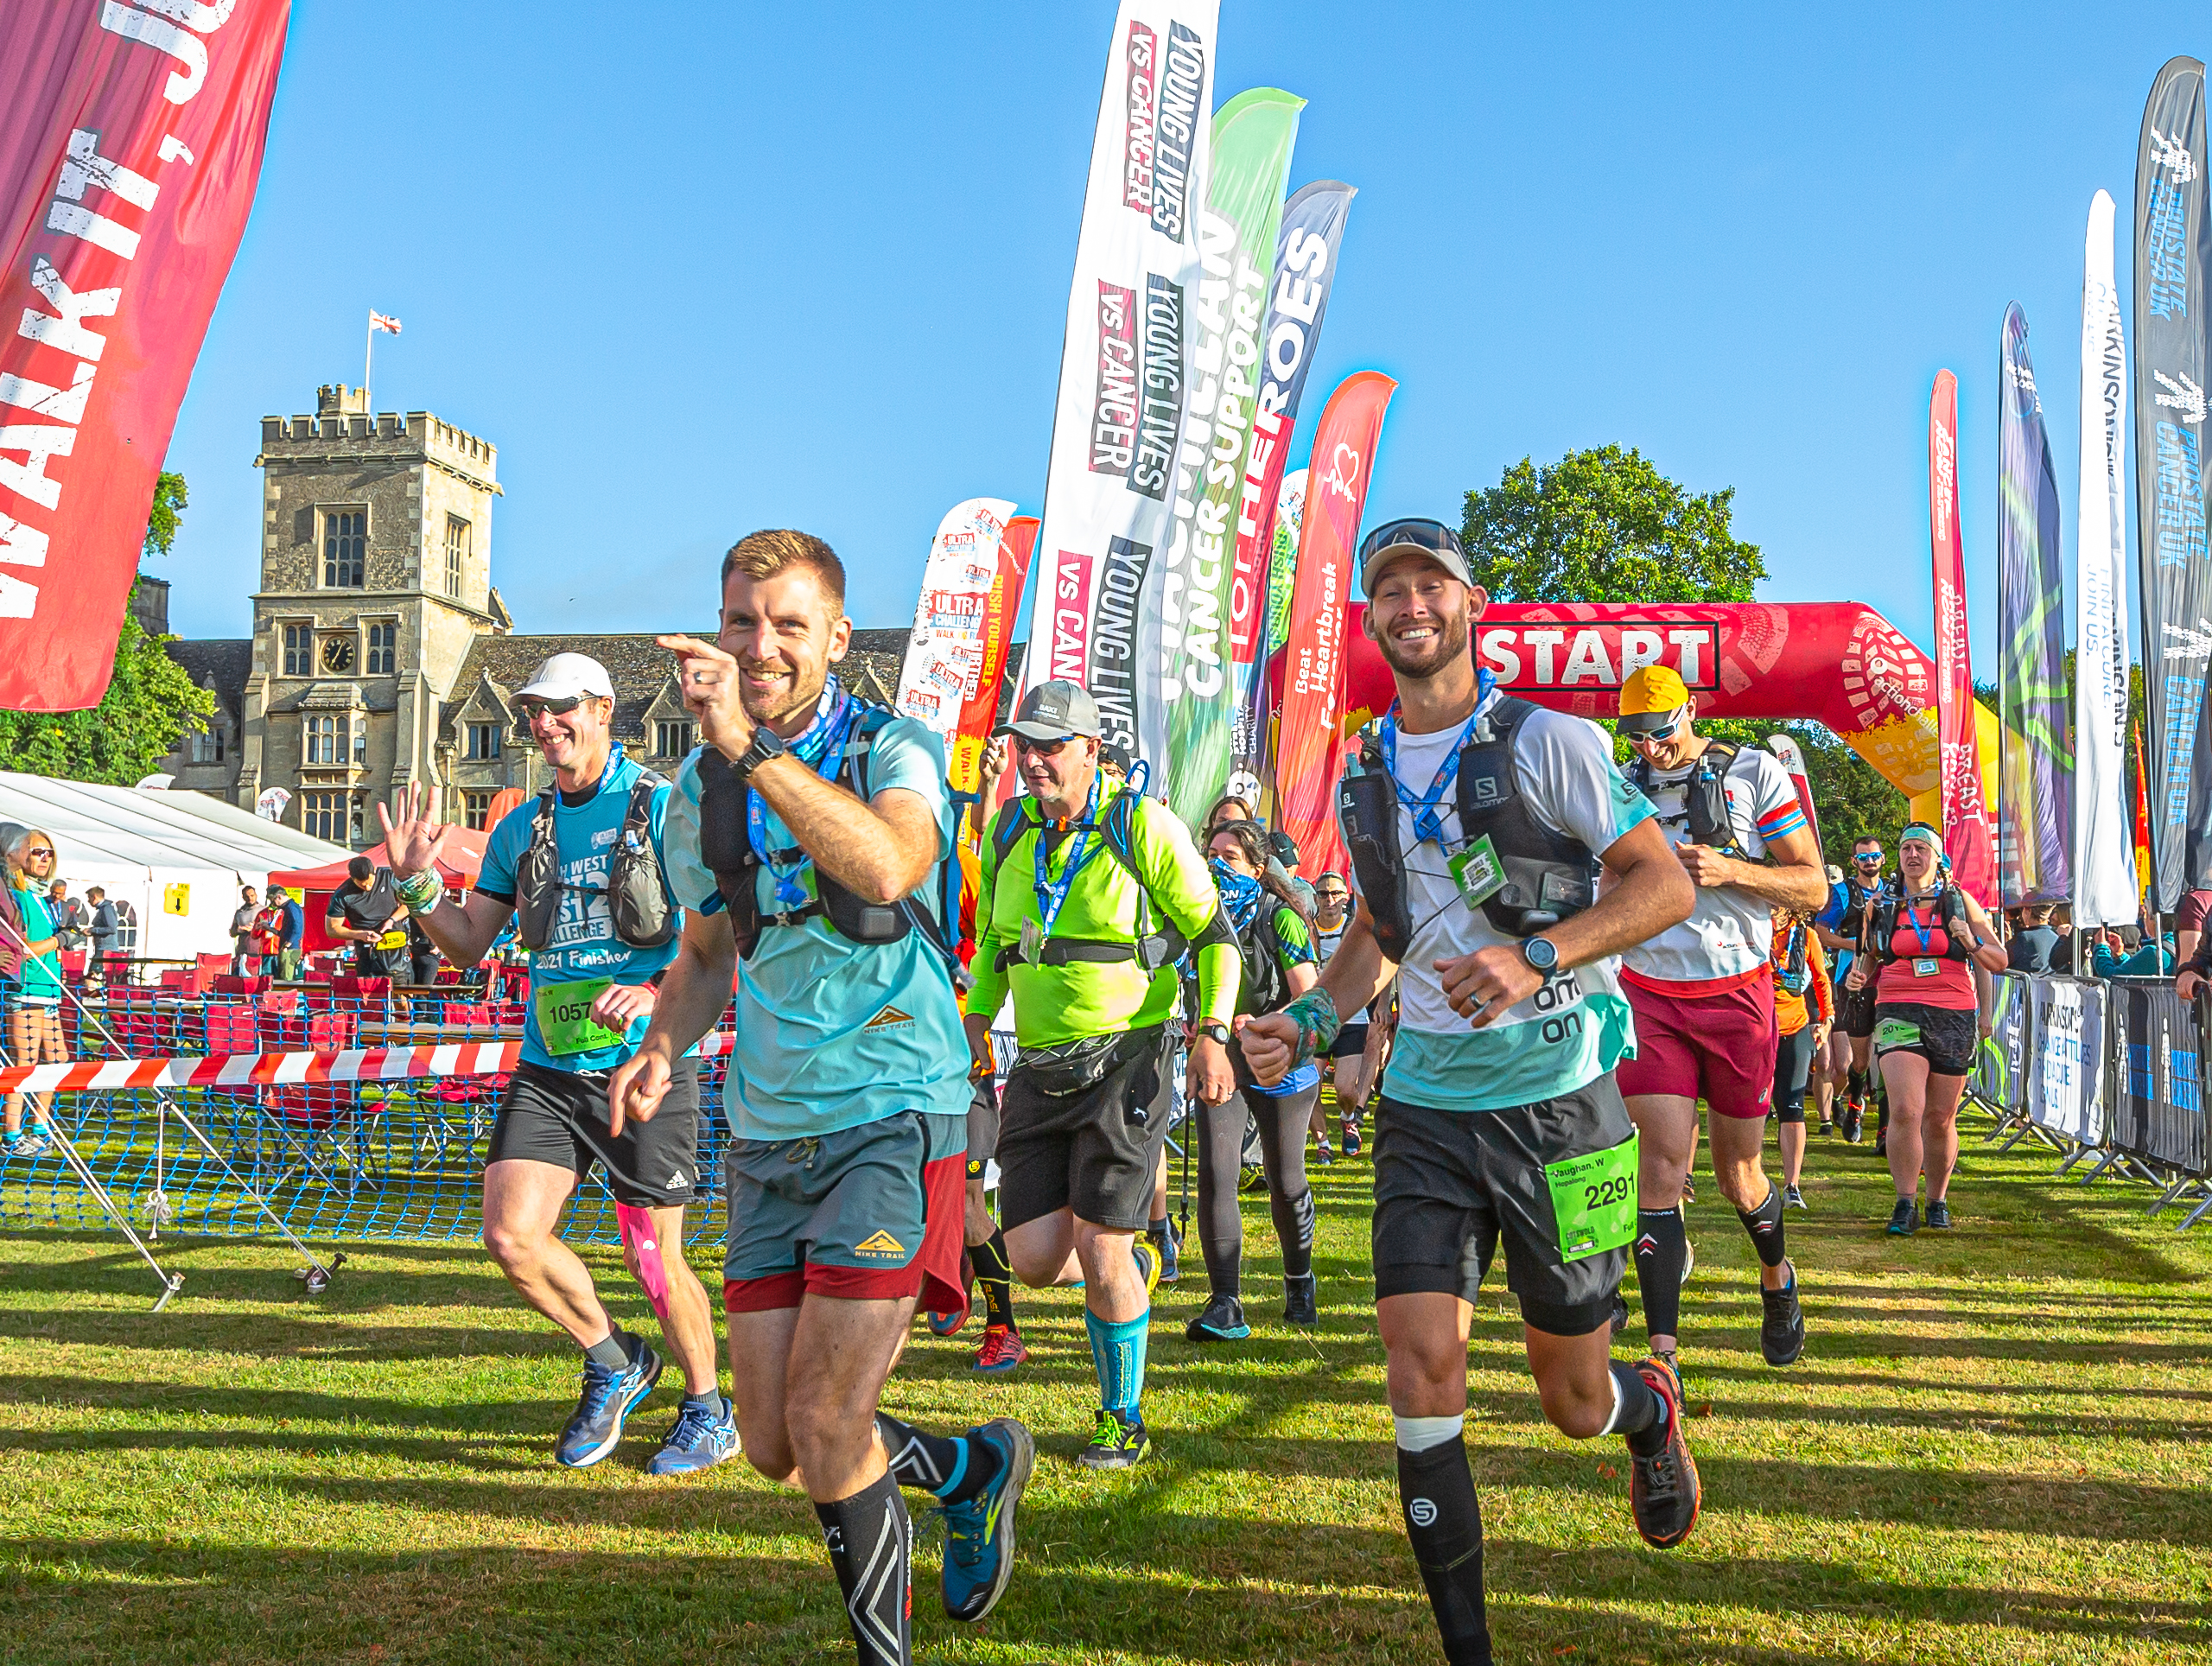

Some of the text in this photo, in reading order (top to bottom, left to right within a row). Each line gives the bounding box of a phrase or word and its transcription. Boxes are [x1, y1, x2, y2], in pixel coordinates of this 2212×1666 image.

[1127, 33, 1153, 210] VS CANCER
[1153, 33, 1203, 238] YOUNG LIVES
[1093, 294, 1135, 467] VS CANCER
[1133, 289, 1180, 493] YOUNG LIVES
[1185, 255, 1265, 697] CANCER SUPPORT
[2156, 420, 2186, 570] CANCER UK
[2180, 428, 2210, 562] PROSTATE
[947, 534, 974, 545] ULTRA
[968, 565, 990, 578] ULTRA
[935, 594, 985, 616] ULTRA
[935, 614, 982, 628] CHALLENG
[936, 629, 954, 638] WALK
[982, 575, 1004, 688] PUSH YOURSELF
[1051, 562, 1086, 690] VS CAN
[1309, 563, 1337, 694] Heartbreak
[1090, 550, 1147, 750] YOUNG LIVES
[1481, 629, 1709, 685] START
[935, 663, 962, 688] ULTRA
[1294, 647, 1312, 694] Beat
[910, 691, 938, 709] ULTRA
[1244, 704, 1257, 754] CHARITY
[2164, 675, 2196, 784] CANCER
[961, 747, 972, 785] WALK
[570, 854, 607, 874] WEST
[550, 921, 605, 945] ALLENGE
[535, 949, 632, 970] 2021 Finisher
[549, 1001, 593, 1024] 1057
[889, 1021, 916, 1031] TRAIL
[1541, 1011, 1583, 1044] on
[1553, 1157, 1605, 1179] Vaughan, W
[1555, 1176, 1587, 1188] Hopalong
[1585, 1171, 1635, 1211] 2291
[855, 1250, 906, 1260] NIKE TRAIL
